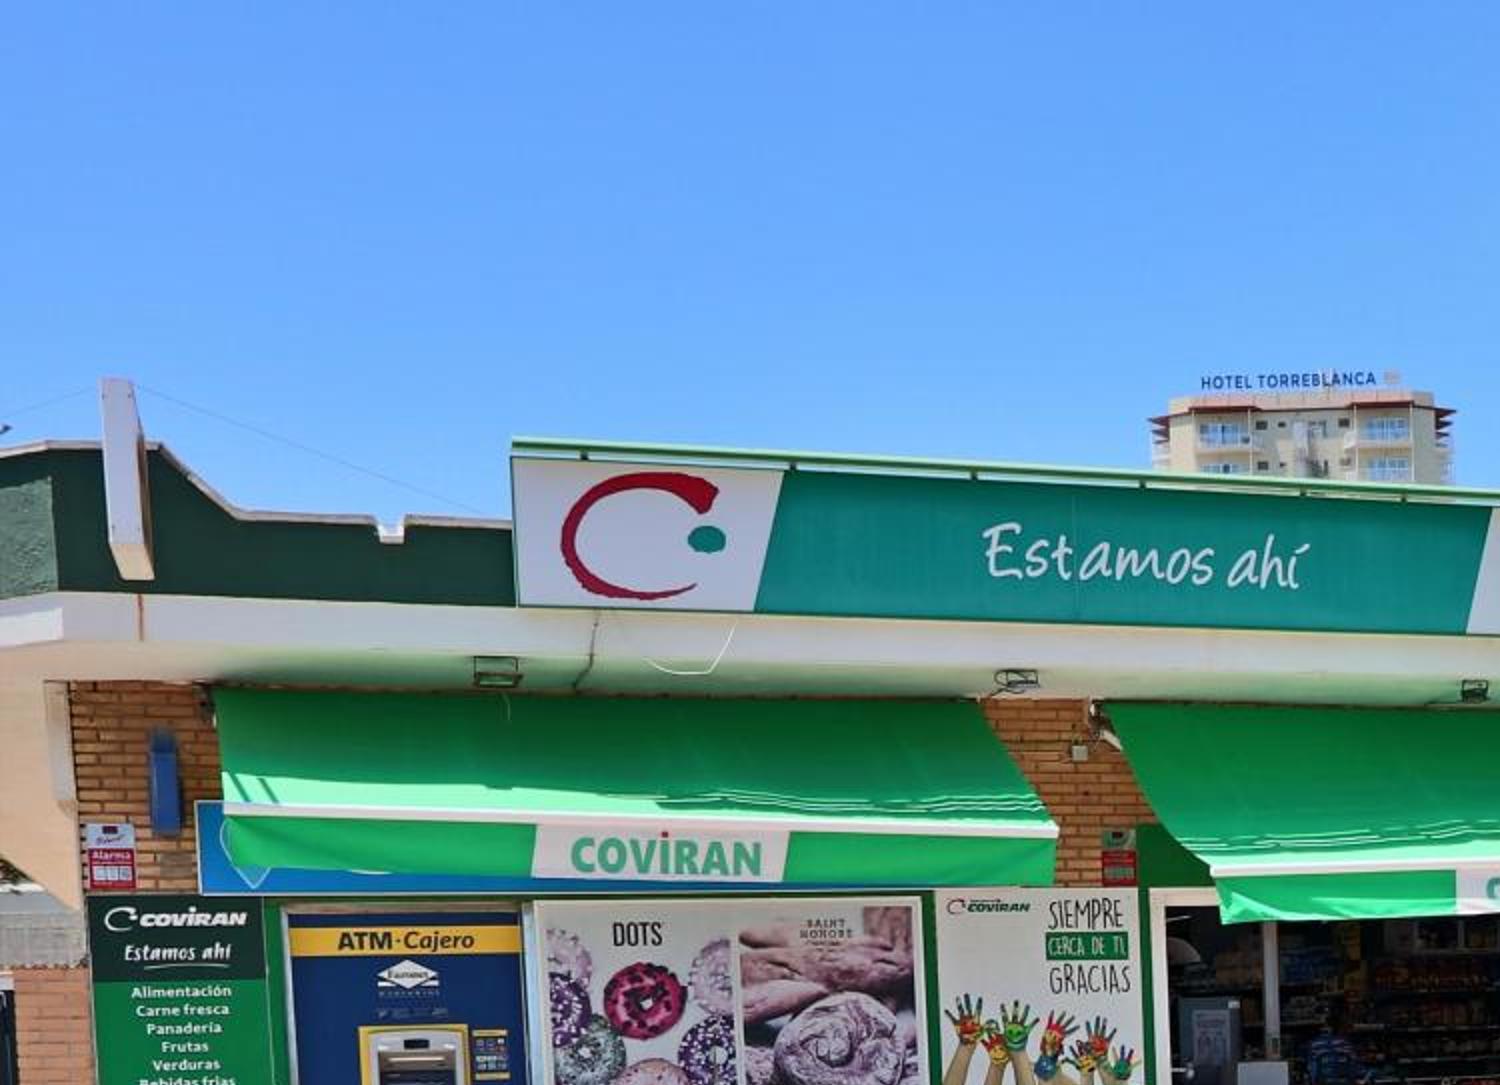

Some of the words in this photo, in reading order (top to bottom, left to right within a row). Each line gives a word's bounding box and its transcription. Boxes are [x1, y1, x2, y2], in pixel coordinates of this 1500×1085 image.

[1200, 375, 1252, 390] HOTEL
[1258, 371, 1377, 389] TORREBLANCA
[981, 521, 1215, 585] Estamos
[1226, 534, 1311, 590] ahí
[570, 831, 762, 876] COVIRAN
[139, 905, 248, 927] COVIRAN
[968, 902, 1031, 913] COVIRAN
[1048, 897, 1124, 930] SIEMPRE
[338, 931, 393, 950] ATM
[403, 931, 475, 952] Cajero
[612, 921, 663, 947] DOTS
[124, 944, 196, 961] Estamos
[1049, 935, 1084, 957] CERCA
[1091, 935, 1105, 956] DE
[1050, 963, 1132, 995] GRACIAS
[131, 985, 232, 999] Alimentación
[135, 1005, 181, 1017] Carne
[183, 1003, 230, 1015] fresca
[146, 1022, 222, 1035] Panadería
[161, 1041, 209, 1053] Frutas
[153, 1059, 221, 1071] Verduras
